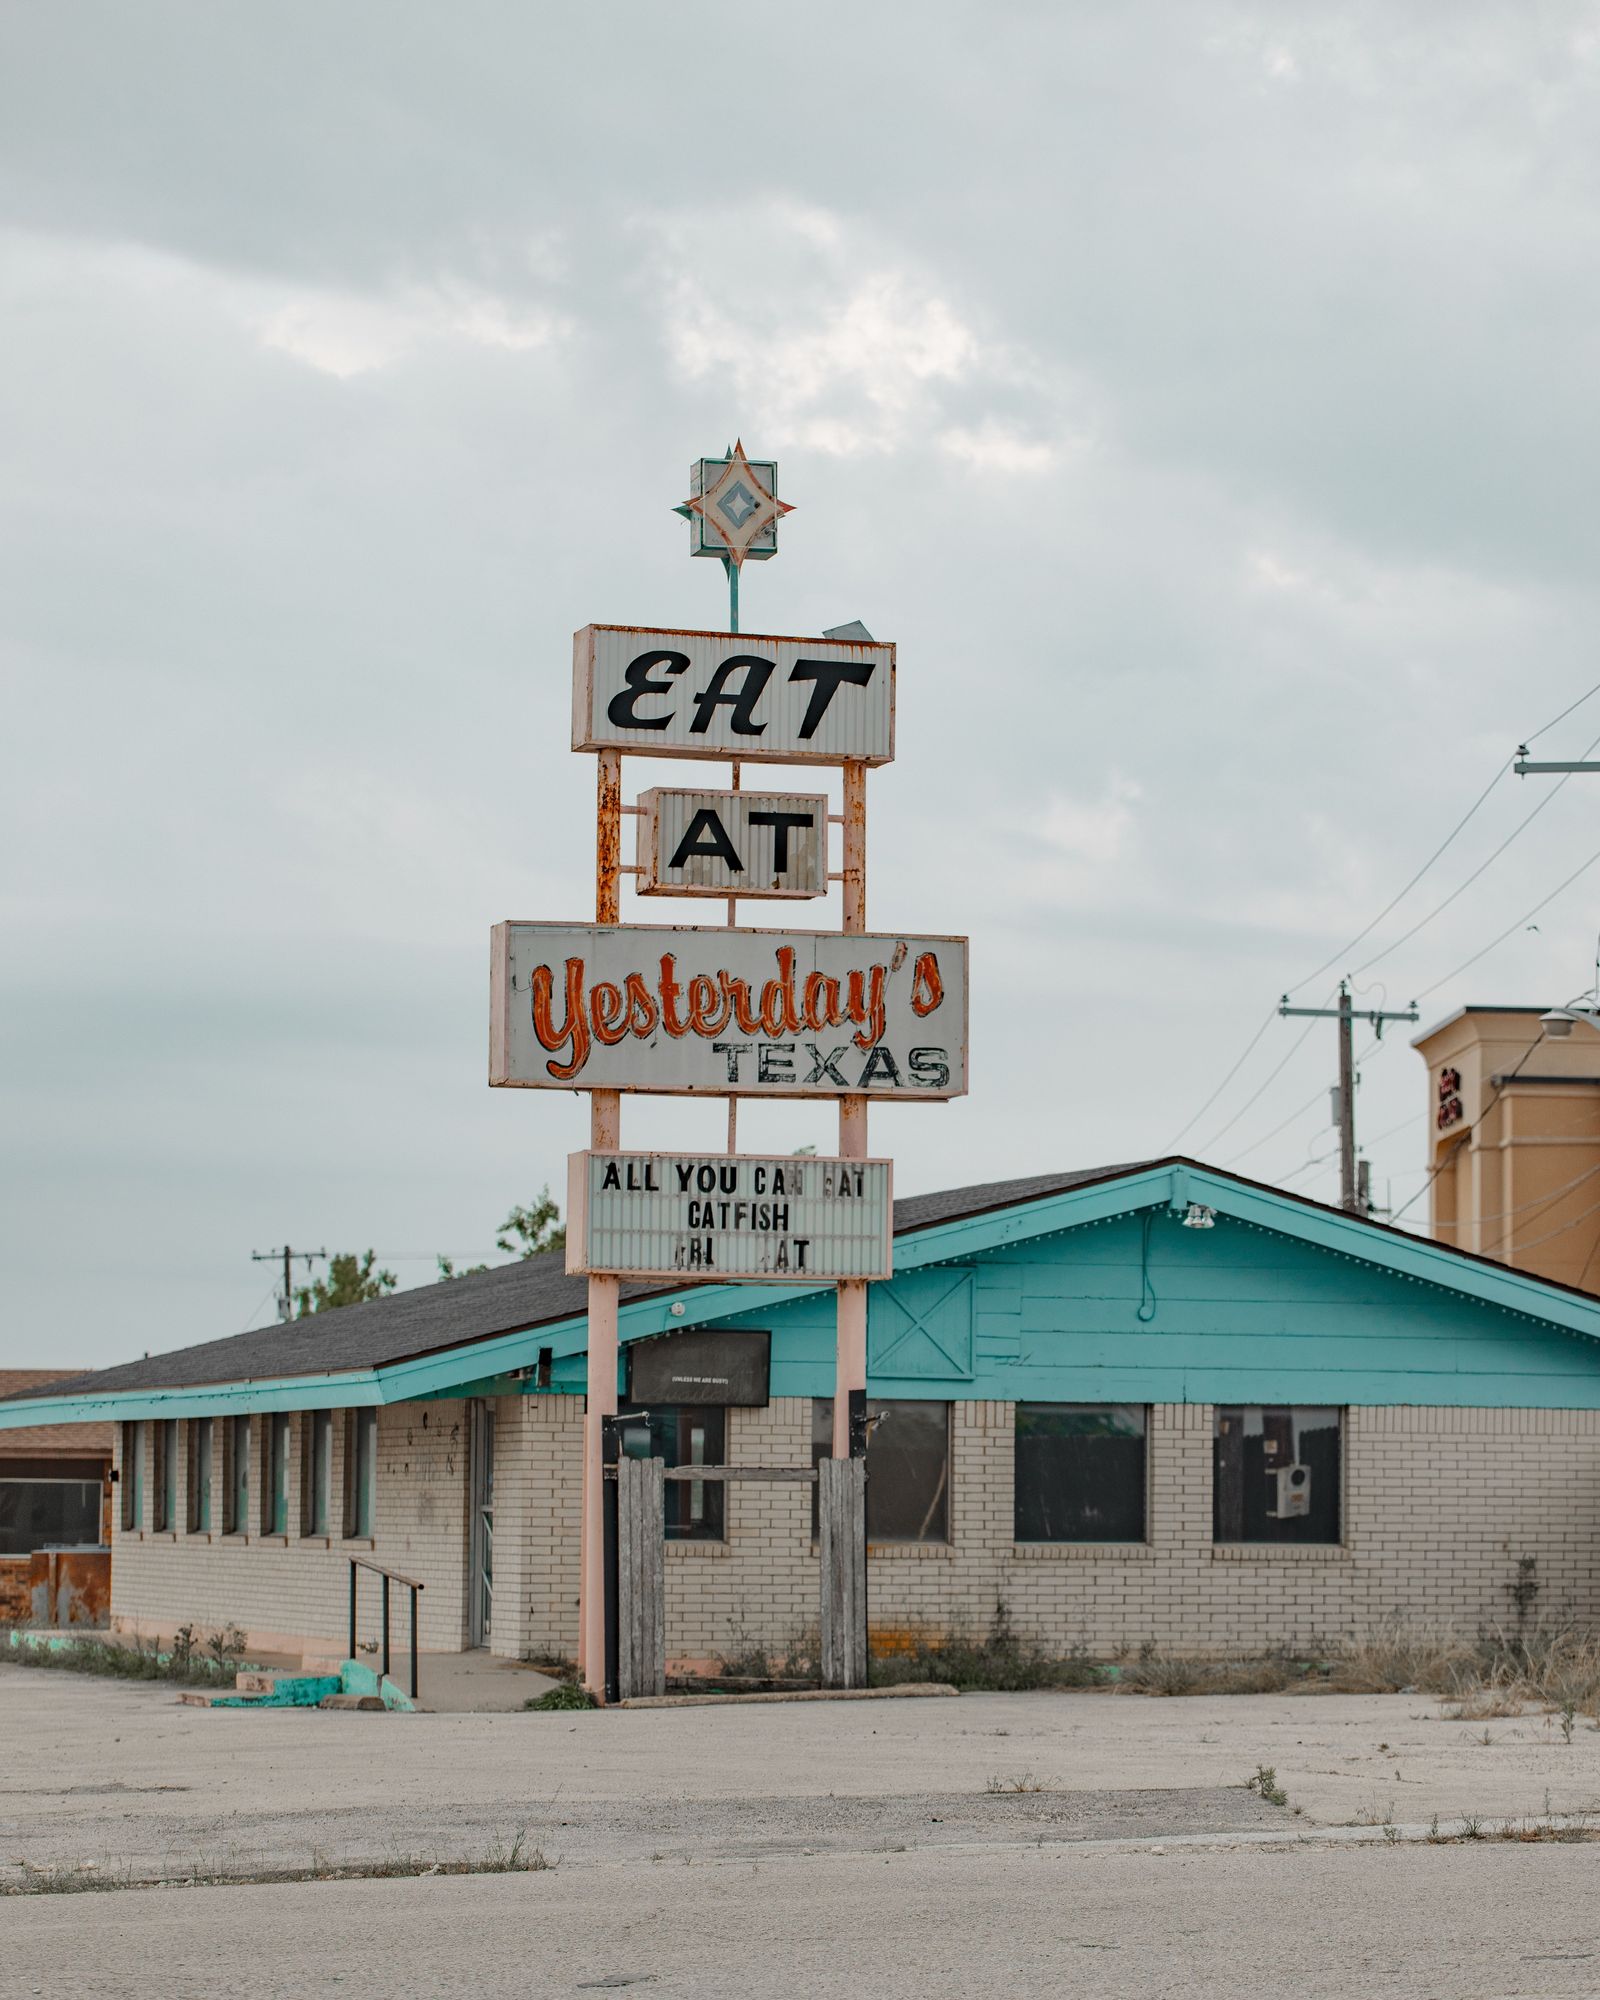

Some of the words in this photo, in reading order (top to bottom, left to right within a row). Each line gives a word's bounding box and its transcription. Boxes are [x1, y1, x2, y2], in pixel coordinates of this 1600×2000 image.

[607, 649, 876, 739] EAT
[668, 808, 814, 873] AT
[530, 942, 945, 1080] Yesterday's
[712, 1042, 949, 1088] TEXAS
[602, 1162, 659, 1191] ALL
[675, 1164, 738, 1194] YOU
[688, 1201, 789, 1231] CATFISH
[760, 1240, 810, 1269] AT
